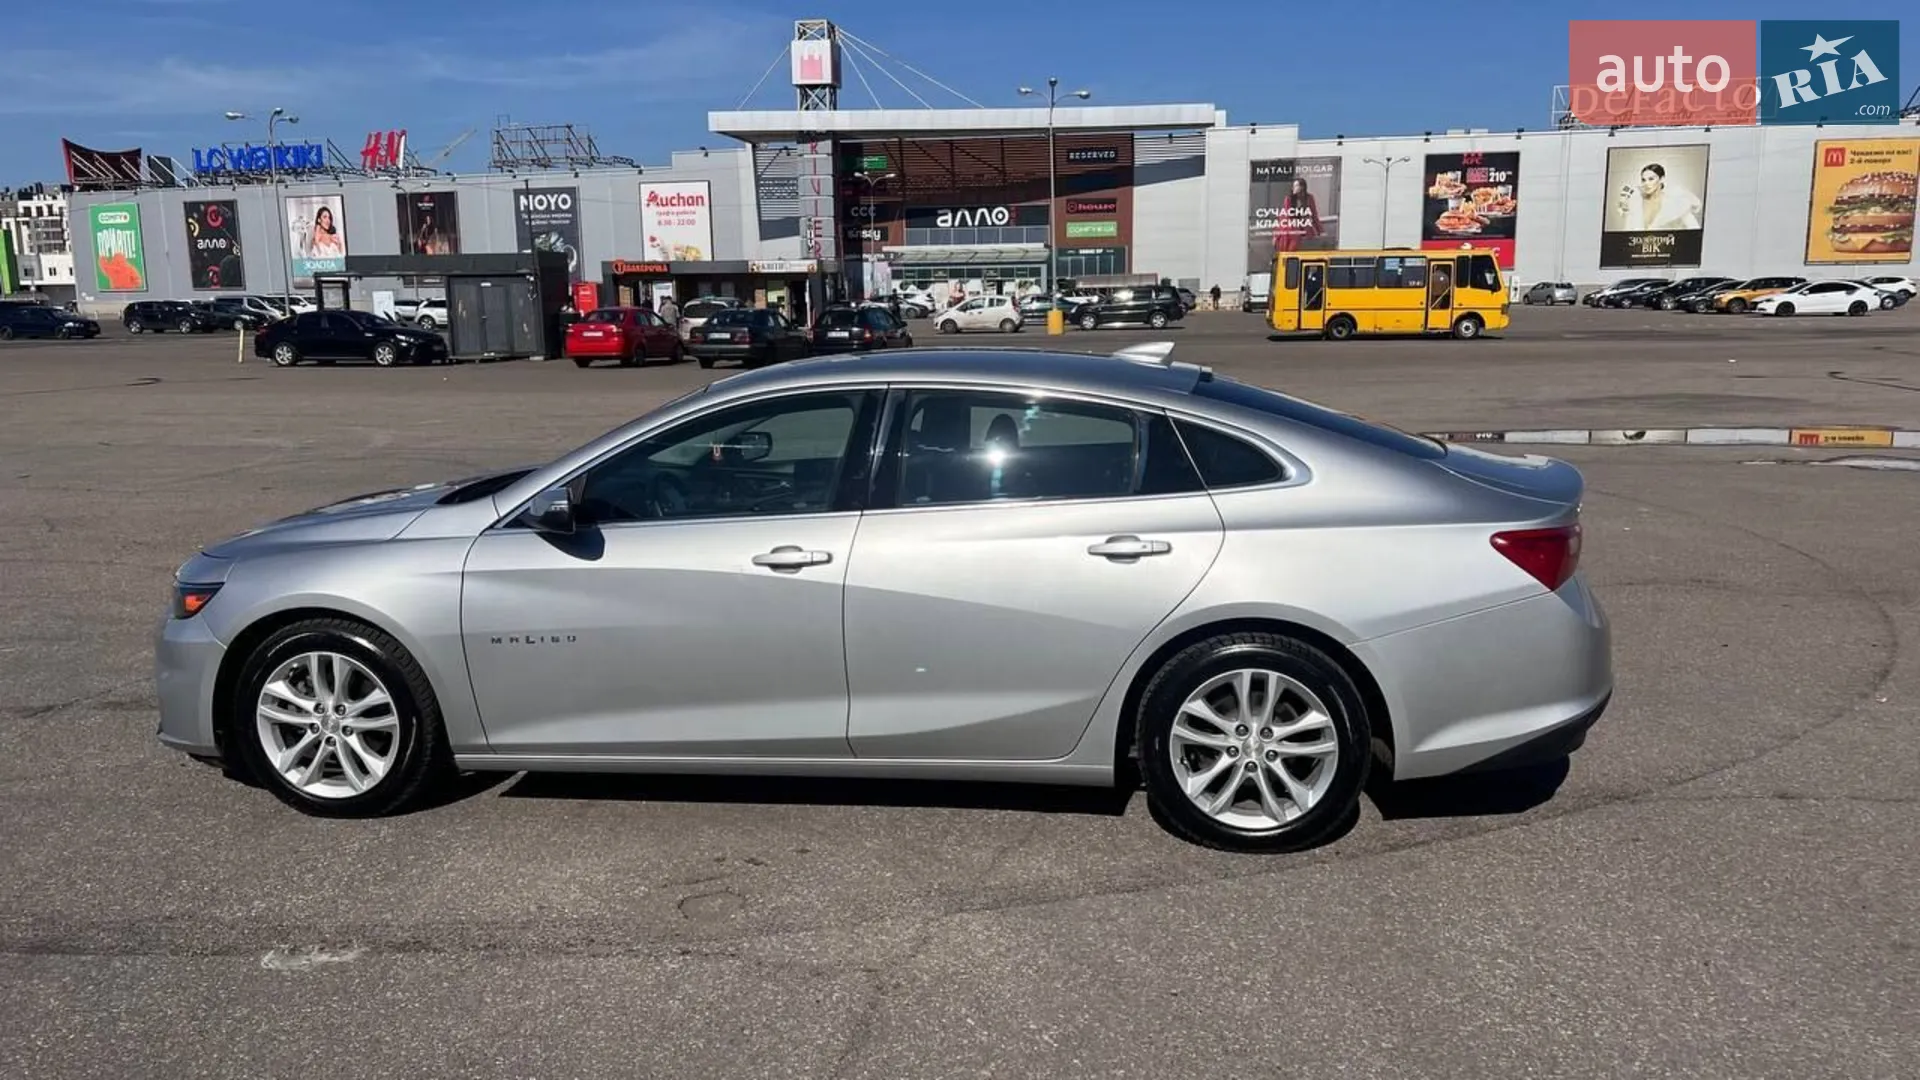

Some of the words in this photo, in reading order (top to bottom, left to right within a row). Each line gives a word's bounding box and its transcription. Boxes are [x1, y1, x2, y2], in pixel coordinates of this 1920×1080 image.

[1069, 150, 1116, 160] RESERVED
[1256, 166, 1292, 175] NATALI
[1296, 164, 1333, 173] BOLGAR
[1489, 171, 1506, 182] 210
[646, 191, 704, 207] Auchan
[851, 206, 877, 216] CCC
[1256, 207, 1312, 218] СУЧАСНА
[1256, 218, 1312, 228] КЛАСИКА
